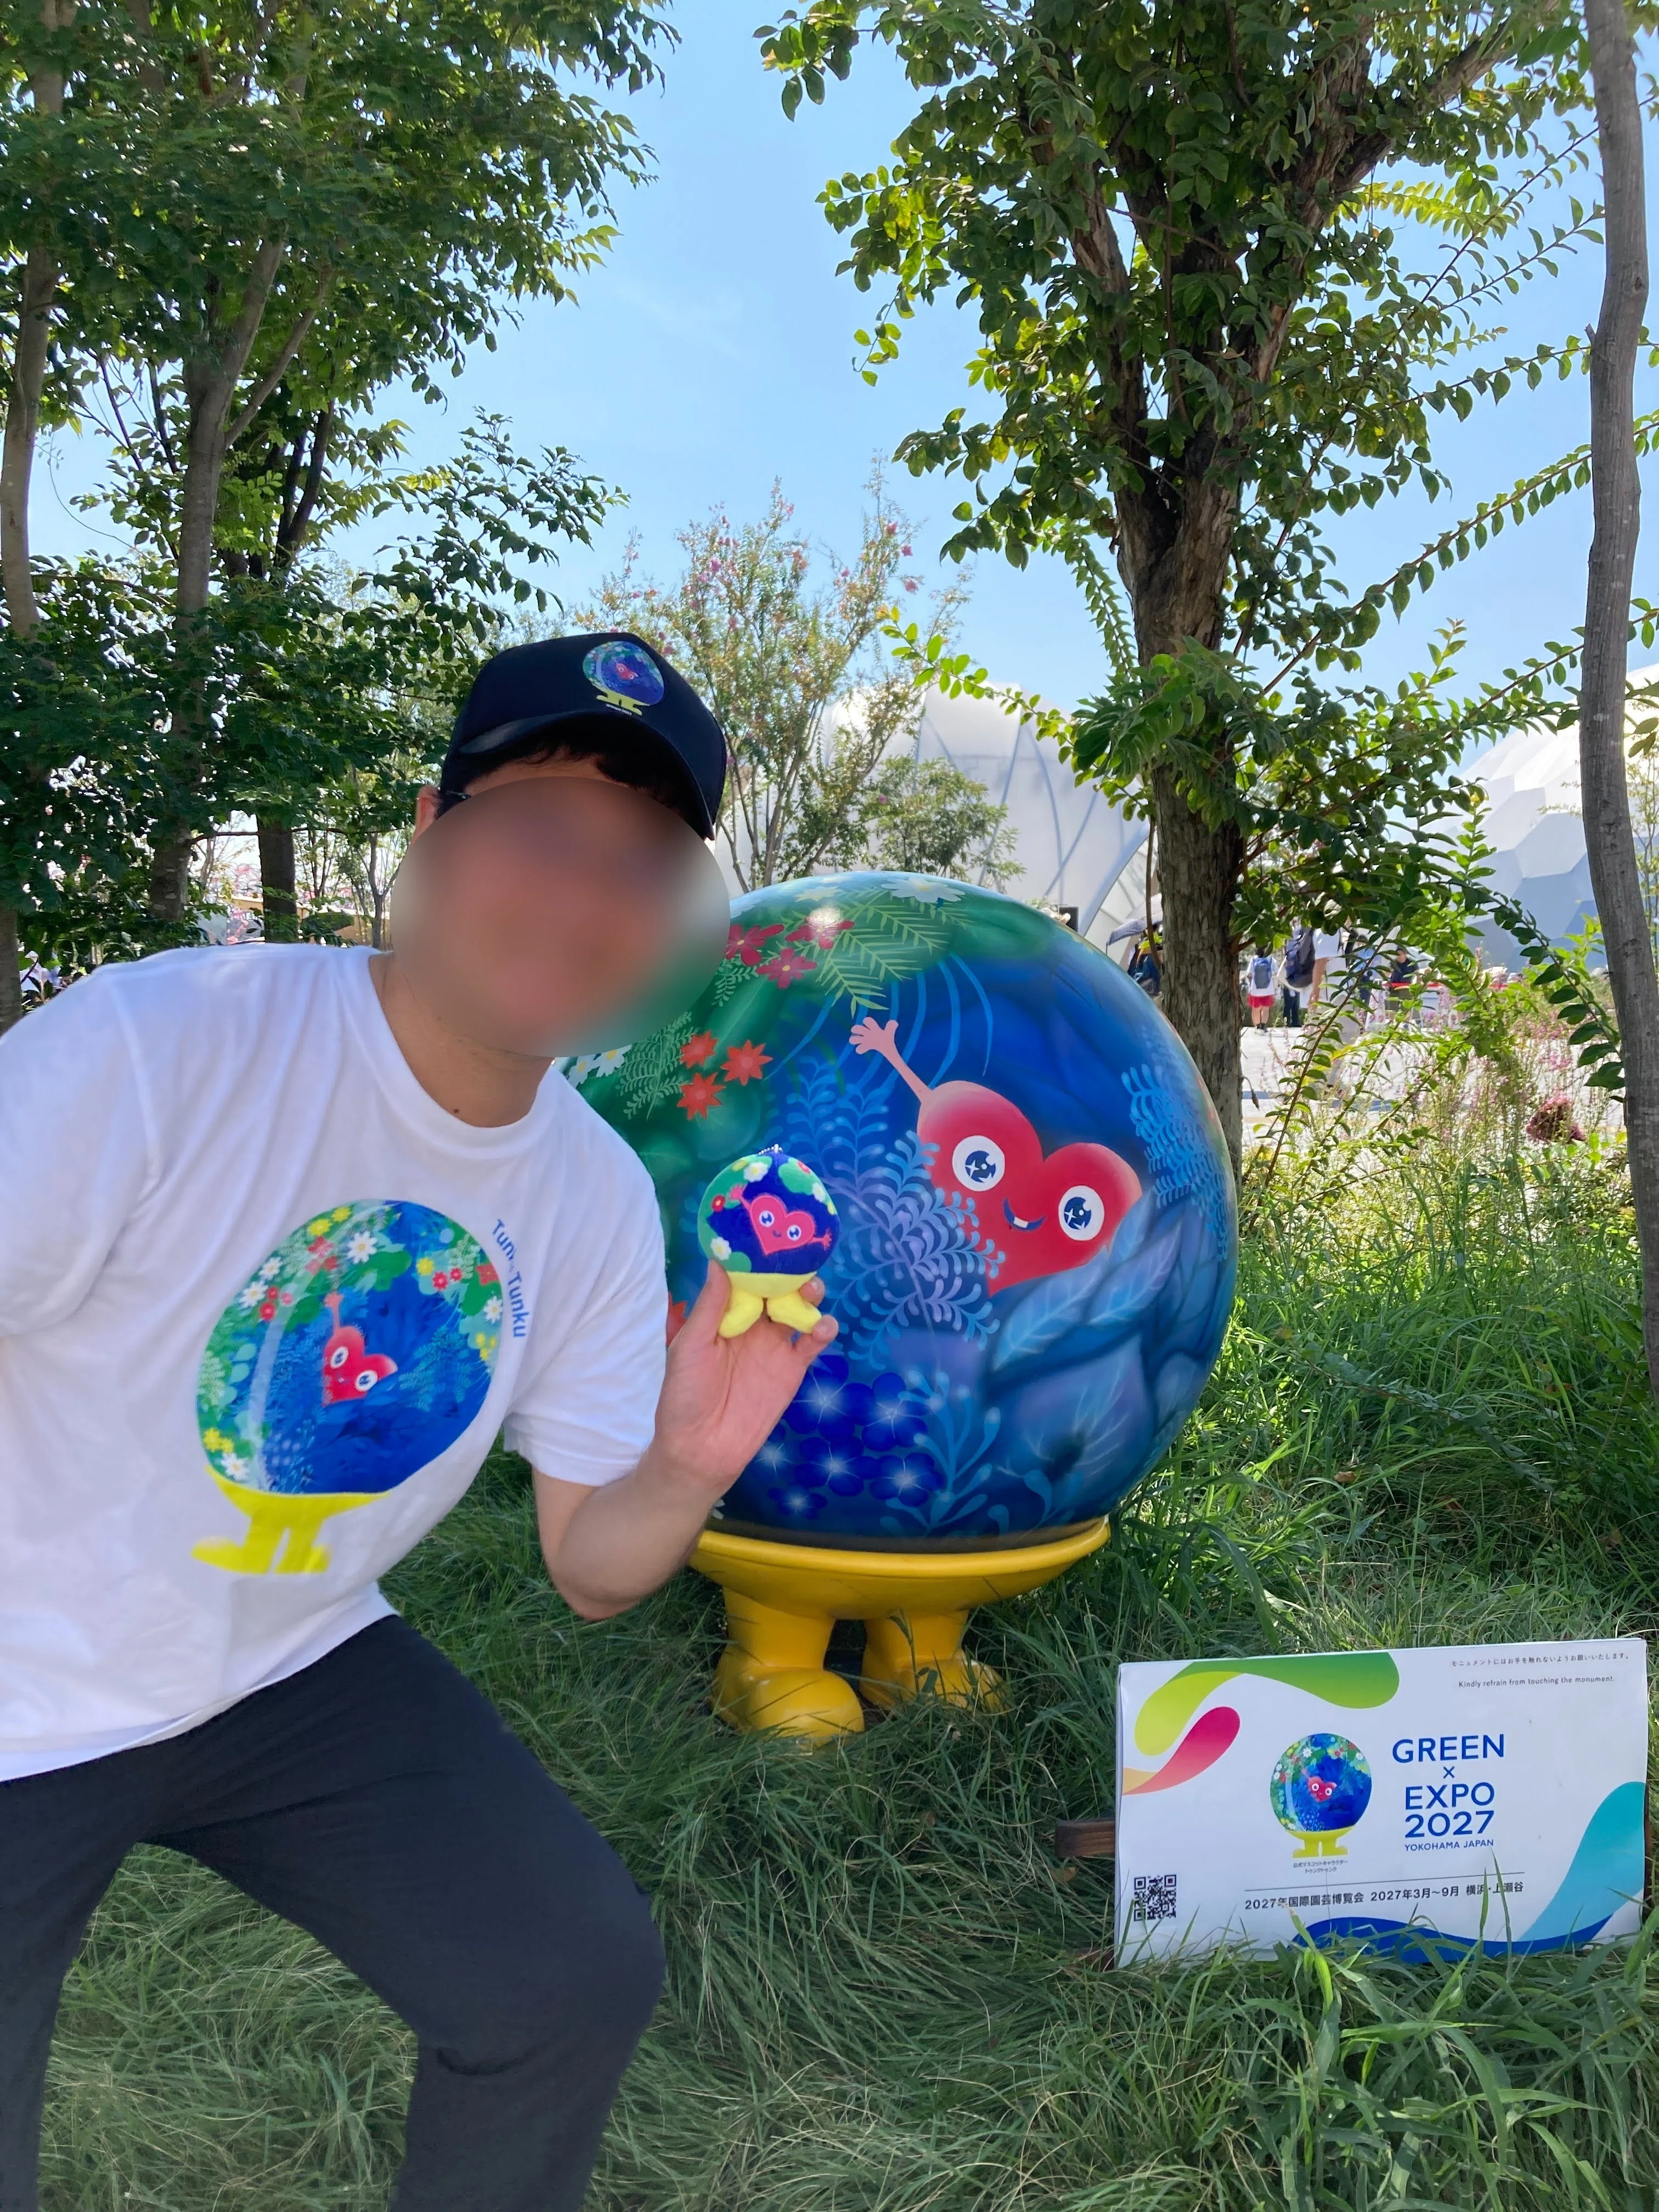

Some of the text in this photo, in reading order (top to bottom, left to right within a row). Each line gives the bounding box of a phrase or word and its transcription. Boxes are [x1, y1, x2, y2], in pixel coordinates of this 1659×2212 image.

[1528, 1677, 1559, 1685] touching
[1392, 1734, 1504, 1763] GREEN
[1405, 1782, 1495, 1810] EXPO
[1405, 1810, 1494, 1838] 2027
[1404, 1839, 1493, 1851] YOKOHAMA JAPAN
[1245, 1892, 1364, 1910] 2027年国際園芸博覧会
